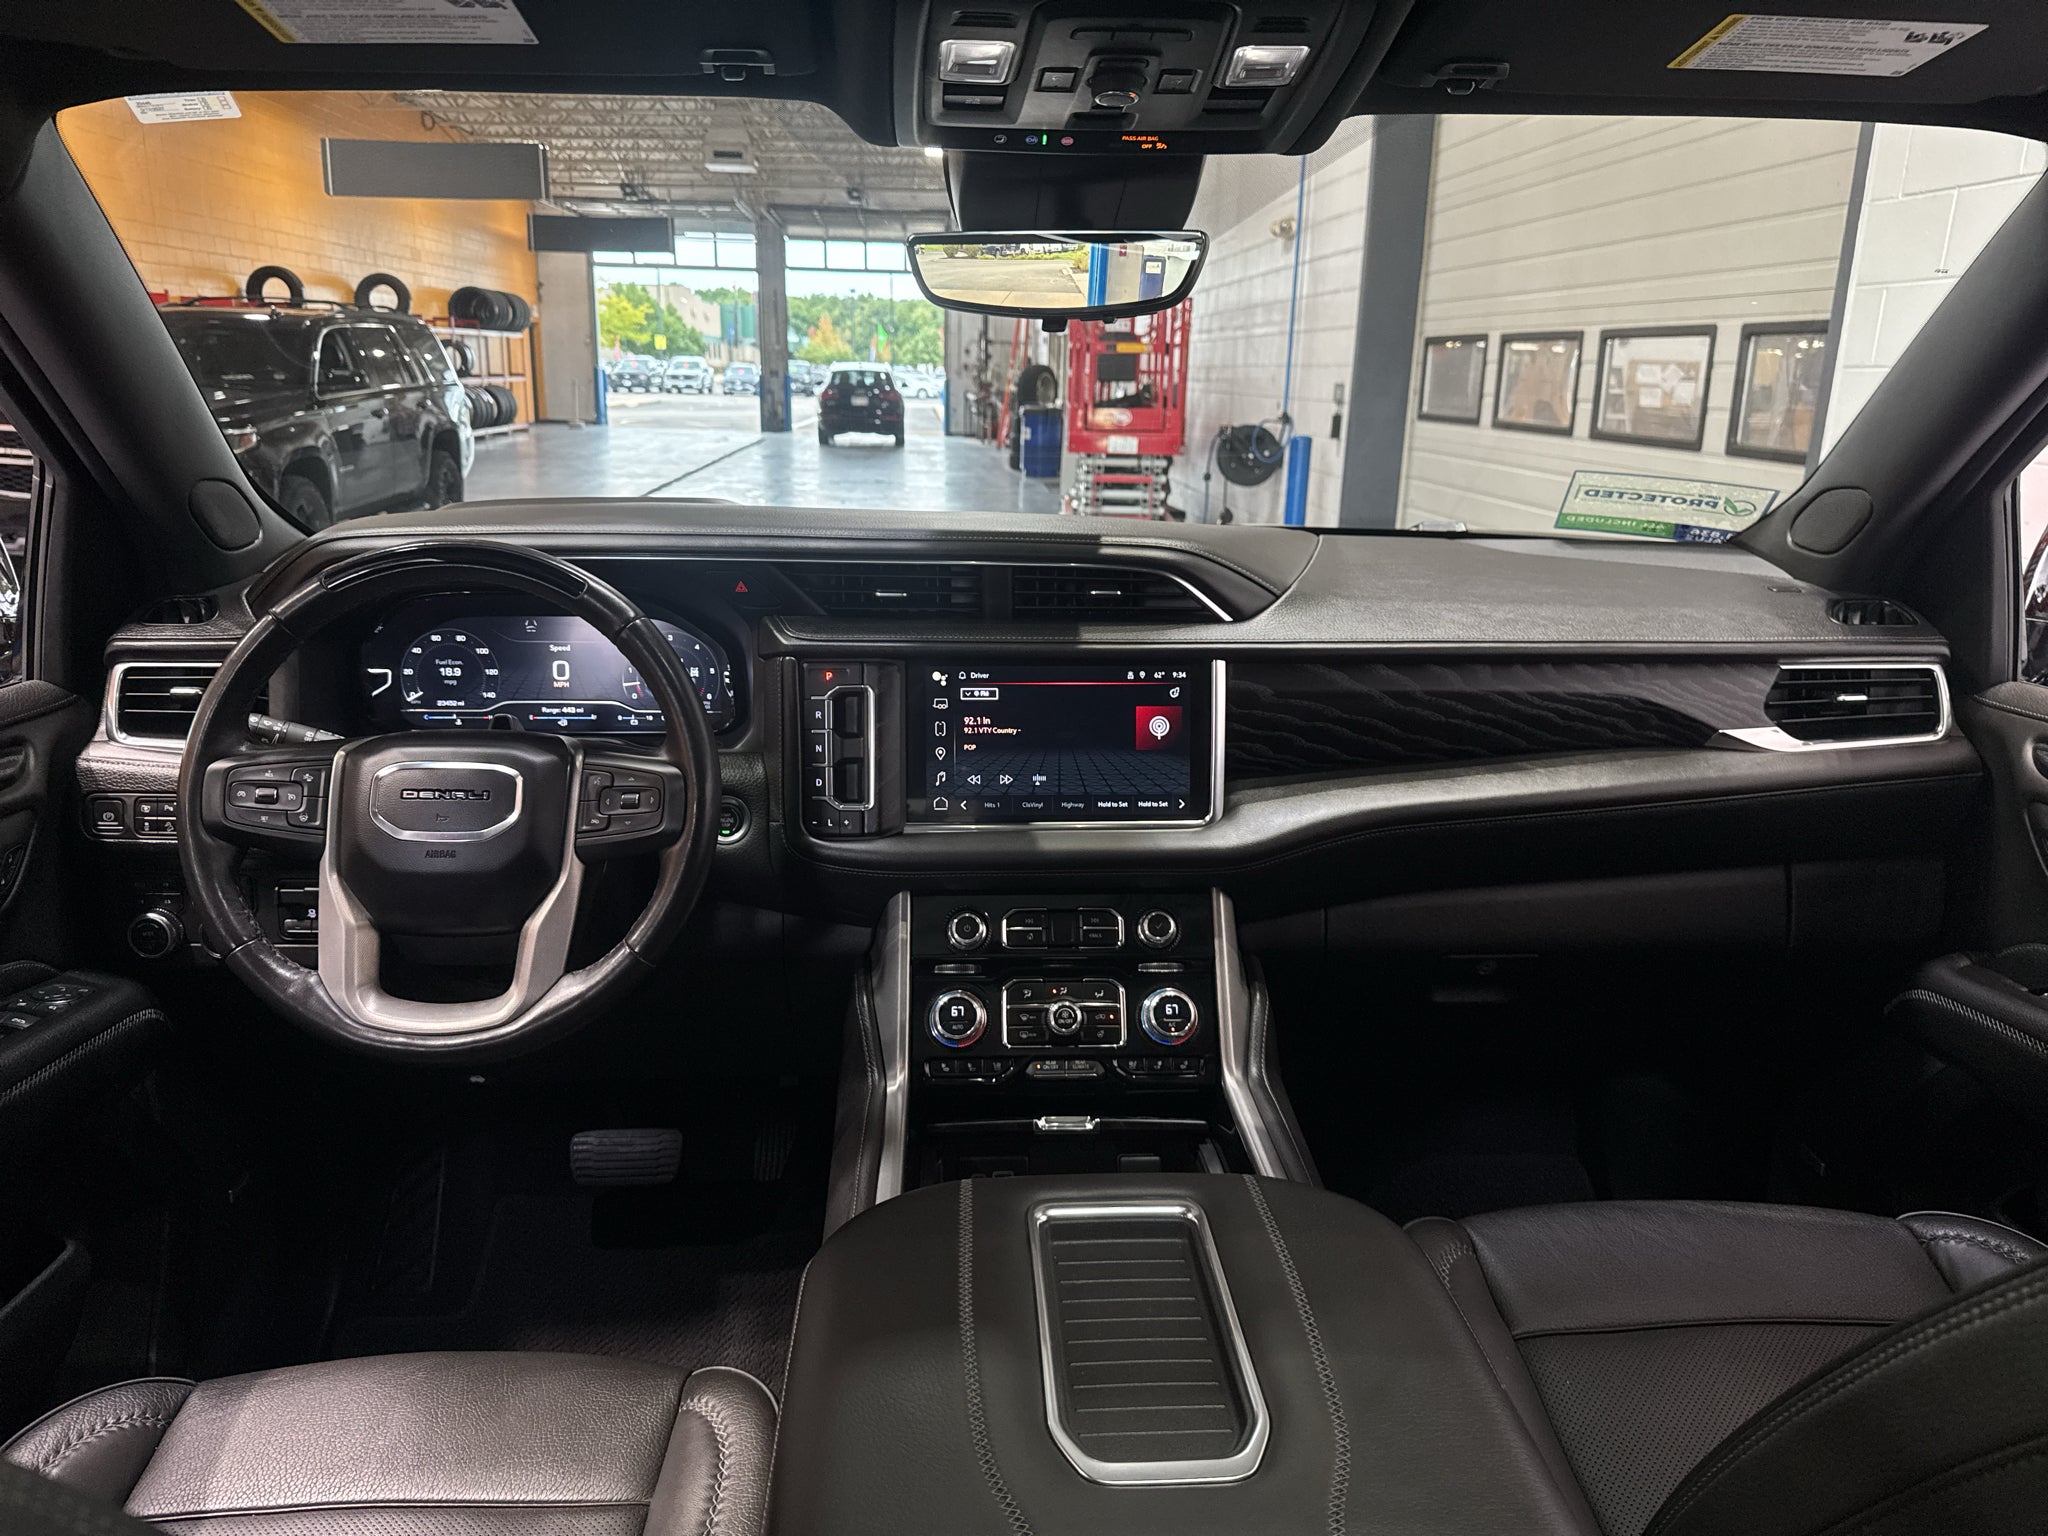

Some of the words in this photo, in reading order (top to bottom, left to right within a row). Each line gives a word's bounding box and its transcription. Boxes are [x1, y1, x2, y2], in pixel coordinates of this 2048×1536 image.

[439, 668, 462, 677] 18.9
[552, 660, 570, 681] 0
[826, 672, 832, 680] P
[815, 710, 822, 719] R
[964, 716, 981, 725] 92.1
[992, 727, 1017, 736] Country
[816, 744, 822, 753] N
[816, 778, 822, 787] D
[401, 788, 490, 800] DENALI
[828, 818, 833, 827] L
[425, 850, 457, 858] AIRBAG
[951, 1006, 964, 1017] 67
[1165, 1004, 1178, 1015] 67
